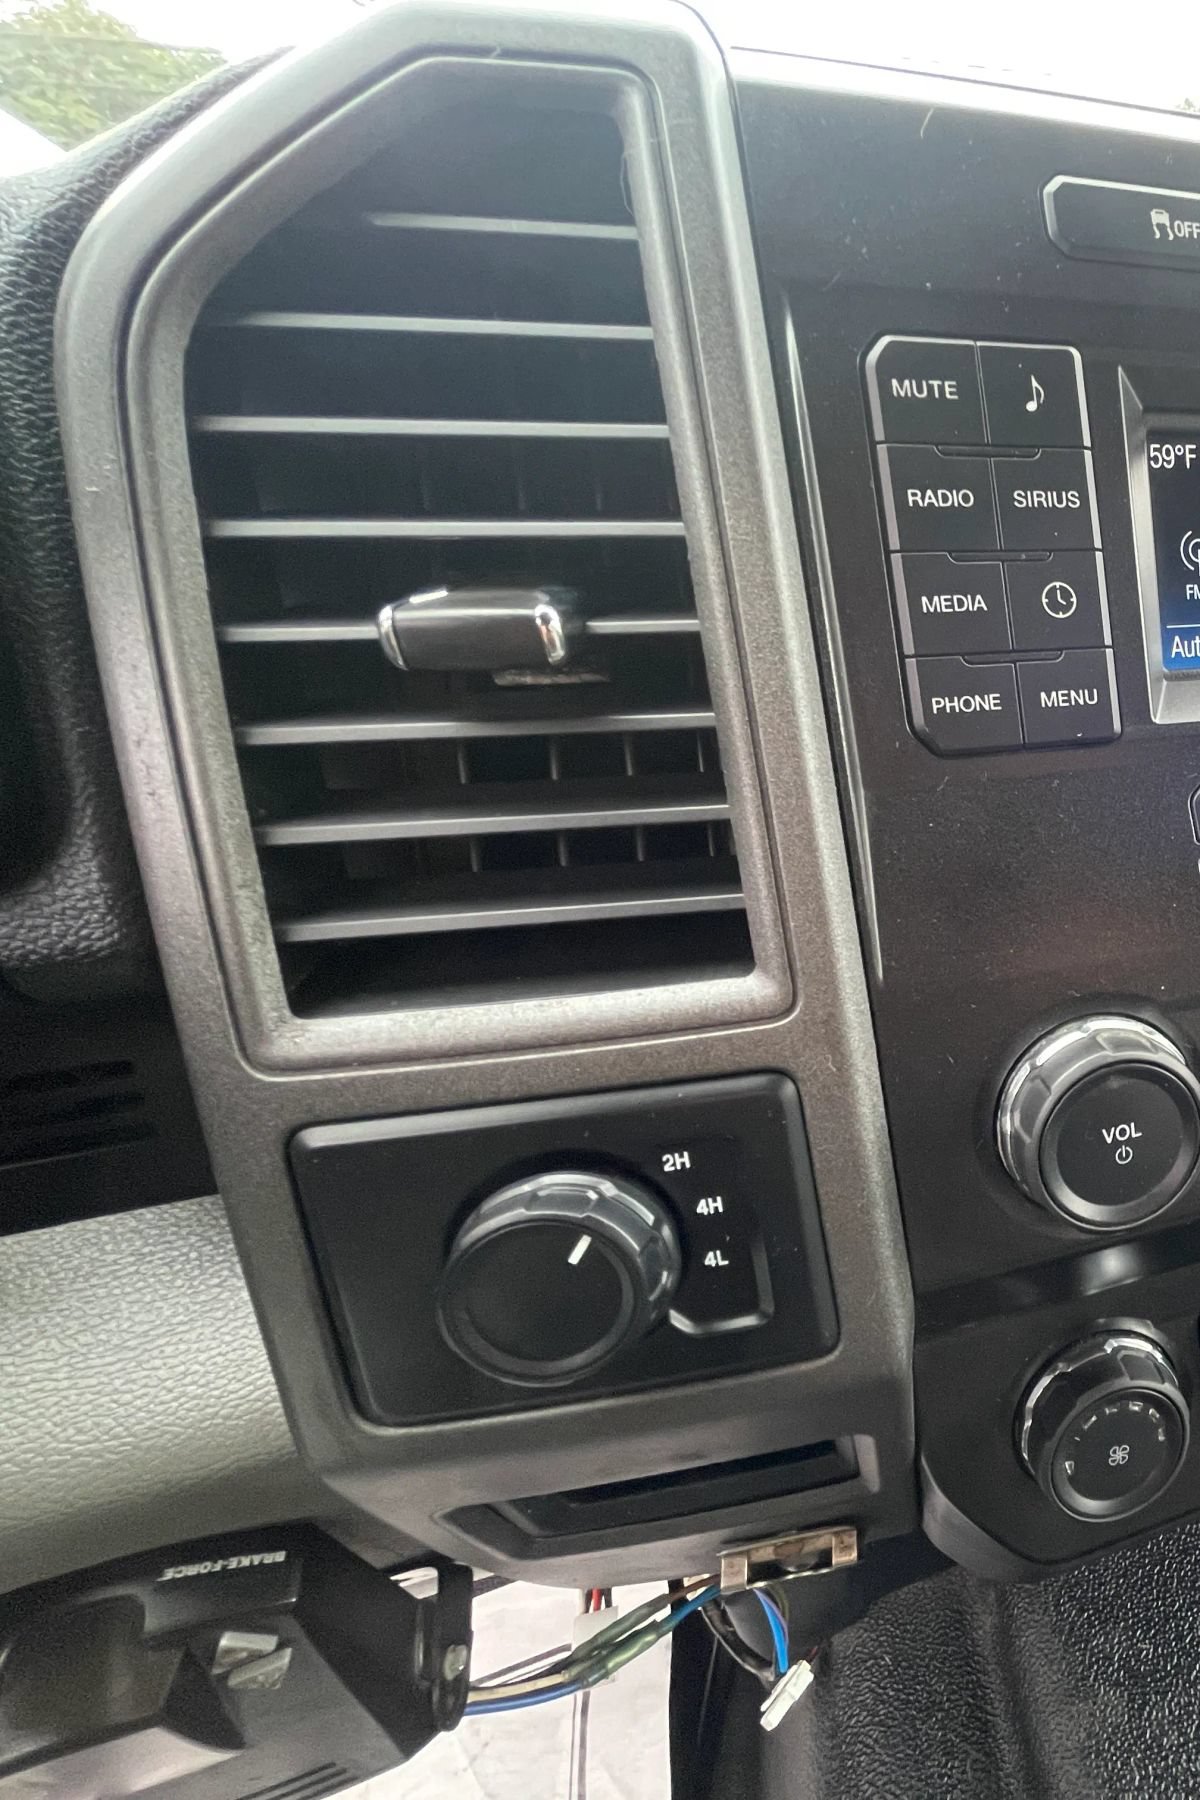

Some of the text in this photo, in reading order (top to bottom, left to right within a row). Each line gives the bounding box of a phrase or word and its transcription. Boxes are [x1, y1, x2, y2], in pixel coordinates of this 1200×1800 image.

[1173, 219, 1200, 239] OFF
[891, 378, 959, 400] MUTE
[1149, 444, 1197, 469] 59°F
[907, 488, 975, 508] RADIO
[1013, 490, 1081, 509] SIRIUS
[921, 594, 988, 614] MEDIA
[931, 693, 1002, 715] PHONE
[1040, 688, 1098, 708] MENU
[1101, 1121, 1143, 1145] VOL
[661, 1150, 691, 1172] 2H
[696, 1195, 724, 1216] 4H
[704, 1249, 729, 1268] 4L
[156, 1550, 287, 1582] BRAKE-FORCE
